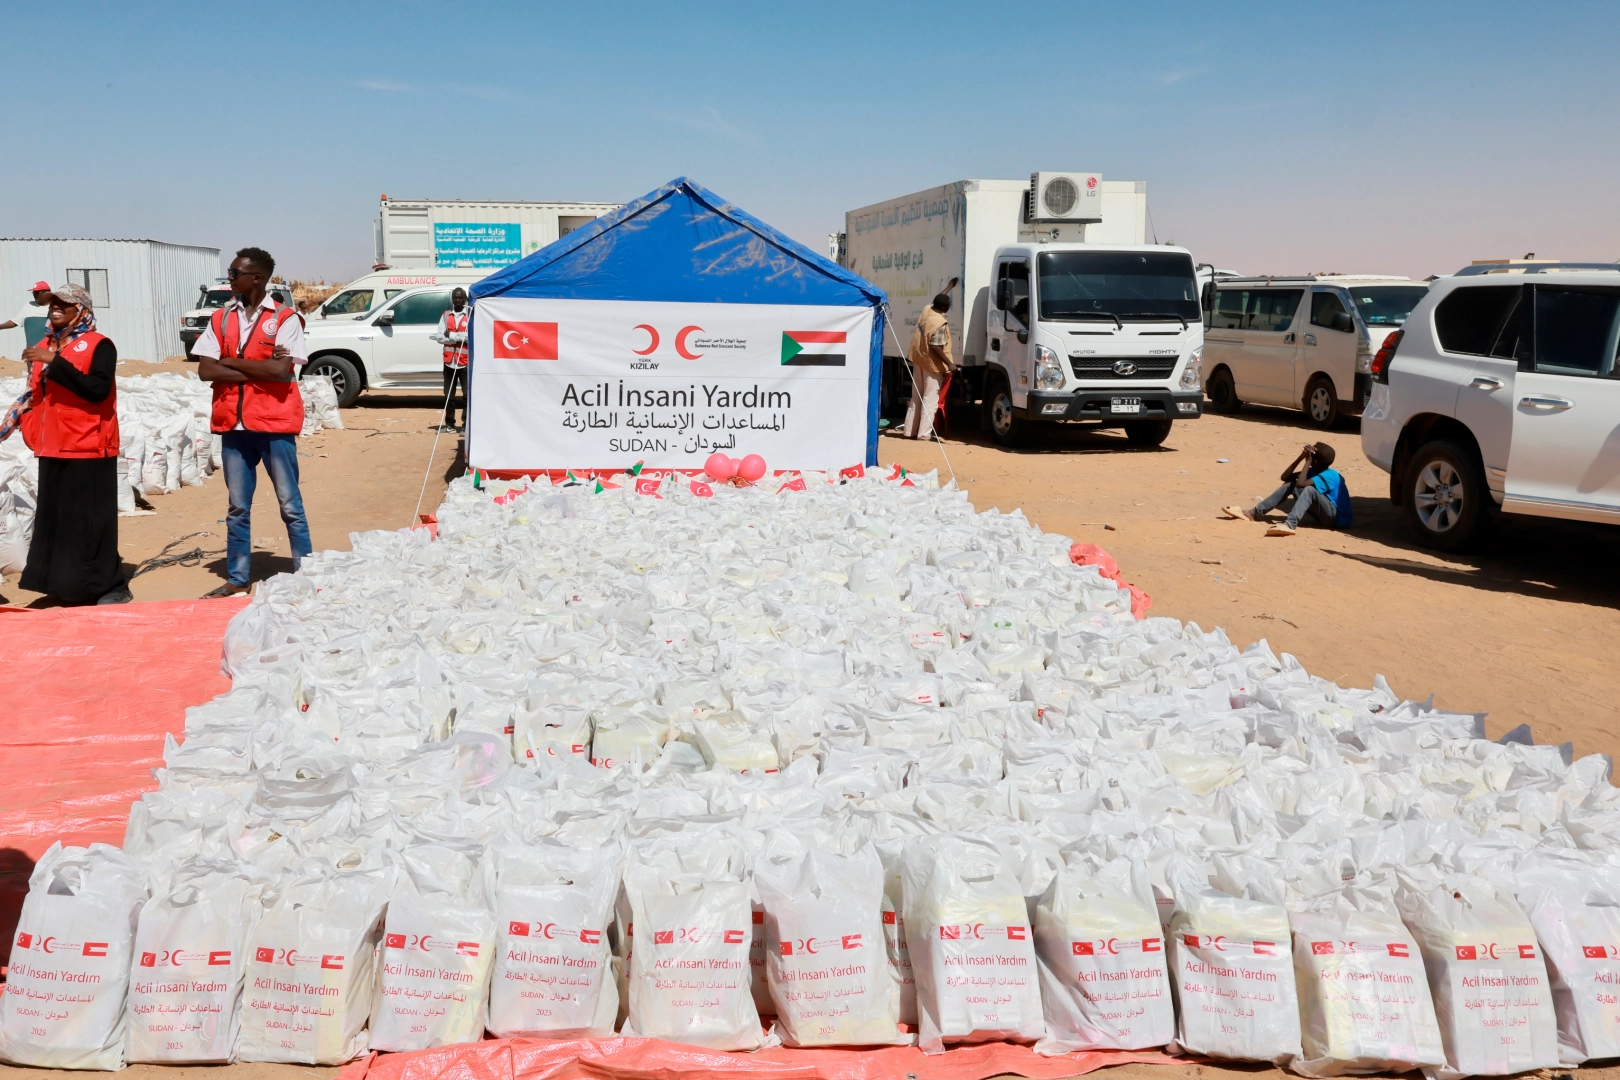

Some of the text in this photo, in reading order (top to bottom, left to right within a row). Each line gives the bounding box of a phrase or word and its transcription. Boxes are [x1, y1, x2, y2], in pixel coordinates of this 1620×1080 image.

[923, 199, 948, 221] جمعية
[894, 251, 910, 271] الولاية
[913, 249, 923, 270] فرع
[561, 379, 791, 409] Acil İnsani Yardım
[562, 411, 785, 435] المساعدات الإنسانية الطارئة
[609, 438, 667, 452] SUDAN
[684, 434, 736, 454] السودان
[507, 950, 596, 968] Acil İnsani Yardım
[966, 953, 994, 965] İnsani
[997, 955, 1027, 965] Yardım
[10, 962, 100, 983] Acil İnsani Yardım
[404, 963, 436, 978] İnsani
[439, 969, 473, 982] Yardım
[799, 968, 829, 981] İnsani
[830, 964, 866, 977] Yardım
[1079, 968, 1162, 981] Acil İnsani Yardım
[1185, 961, 1204, 972] Acil
[1240, 968, 1276, 982] Yardım
[530, 974, 556, 985] الإنسانية
[559, 977, 591, 986] المساعدات
[972, 977, 995, 987] الإنسانية
[998, 978, 1026, 986] المساعدات
[1462, 974, 1538, 987] Acil İnsani Yardım
[1595, 972, 1612, 983] Acil
[156, 981, 188, 992] İnsani
[191, 981, 227, 992] Yardım
[254, 977, 338, 996] Acil İnsani Yardım
[679, 980, 704, 991] الإنسانية
[707, 980, 738, 989] المساعدات
[26, 989, 53, 1002] الإنسانية
[404, 988, 431, 1000] الإنسانية
[434, 992, 466, 1002] المساعدات
[804, 990, 830, 1001] الإنسانية
[834, 986, 866, 997] المساعدات
[1132, 990, 1161, 999] المساعدات
[1210, 986, 1237, 1000] الإنسانية
[56, 994, 94, 1003] المساعدات
[1105, 993, 1129, 1003] الإنسانية
[1514, 998, 1539, 1006] المساعدات
[158, 1004, 187, 1015] الإنسانية
[190, 1004, 222, 1013] المساعدات
[273, 1003, 299, 1015] الإنسانية
[1202, 1005, 1227, 1014] SUDAN
[1488, 999, 1511, 1009] الإنسانية
[16, 1007, 39, 1016] SUDAN
[301, 1007, 334, 1016] المساعدات
[394, 1007, 417, 1015] SUDAN
[800, 1010, 823, 1018] SUDAN
[266, 1021, 287, 1029] SUDAN
[1221, 1025, 1237, 1034] 2025
[31, 1027, 46, 1036] 2025
[1118, 1028, 1130, 1036] 2025
[280, 1040, 295, 1048] 2025
